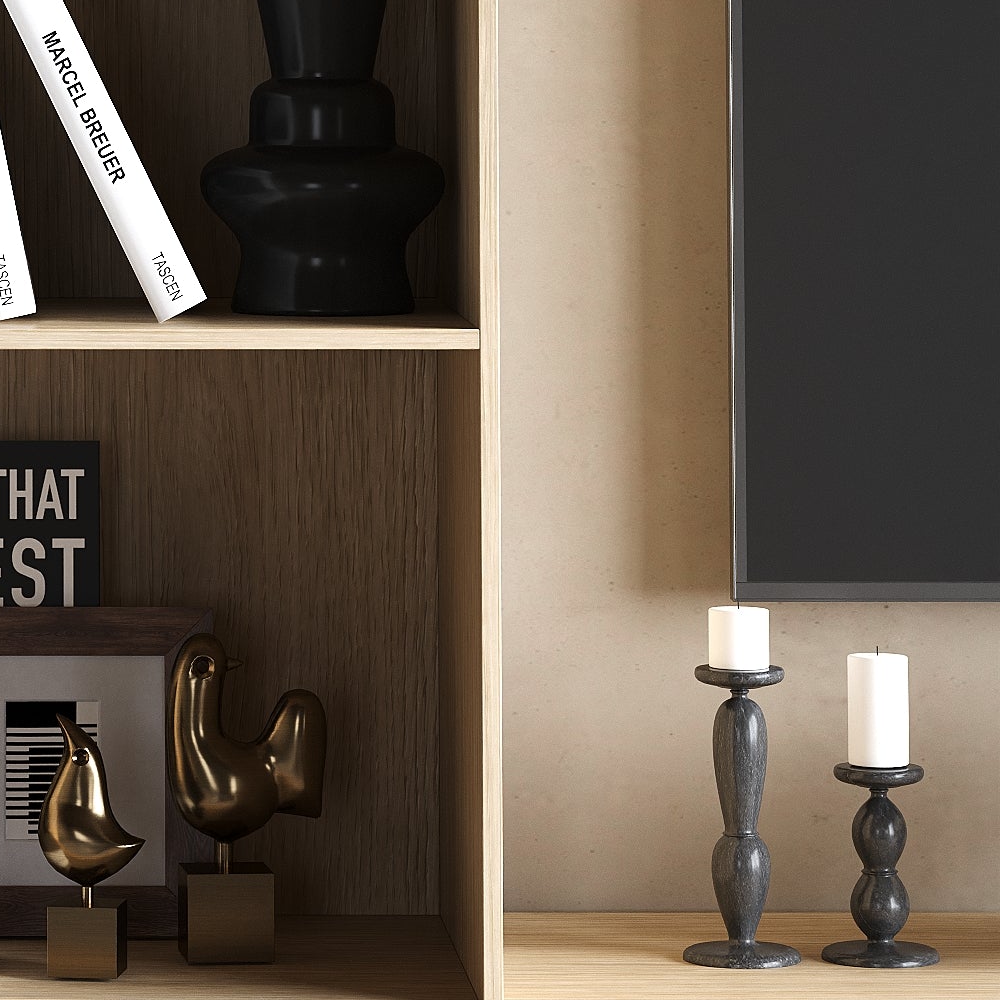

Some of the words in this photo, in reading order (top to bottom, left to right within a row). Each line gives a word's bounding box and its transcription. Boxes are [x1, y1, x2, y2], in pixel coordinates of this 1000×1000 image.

[42, 30, 81, 109] MARCEL
[80, 107, 126, 185] BREUER
[151, 251, 184, 302] TASCEN
